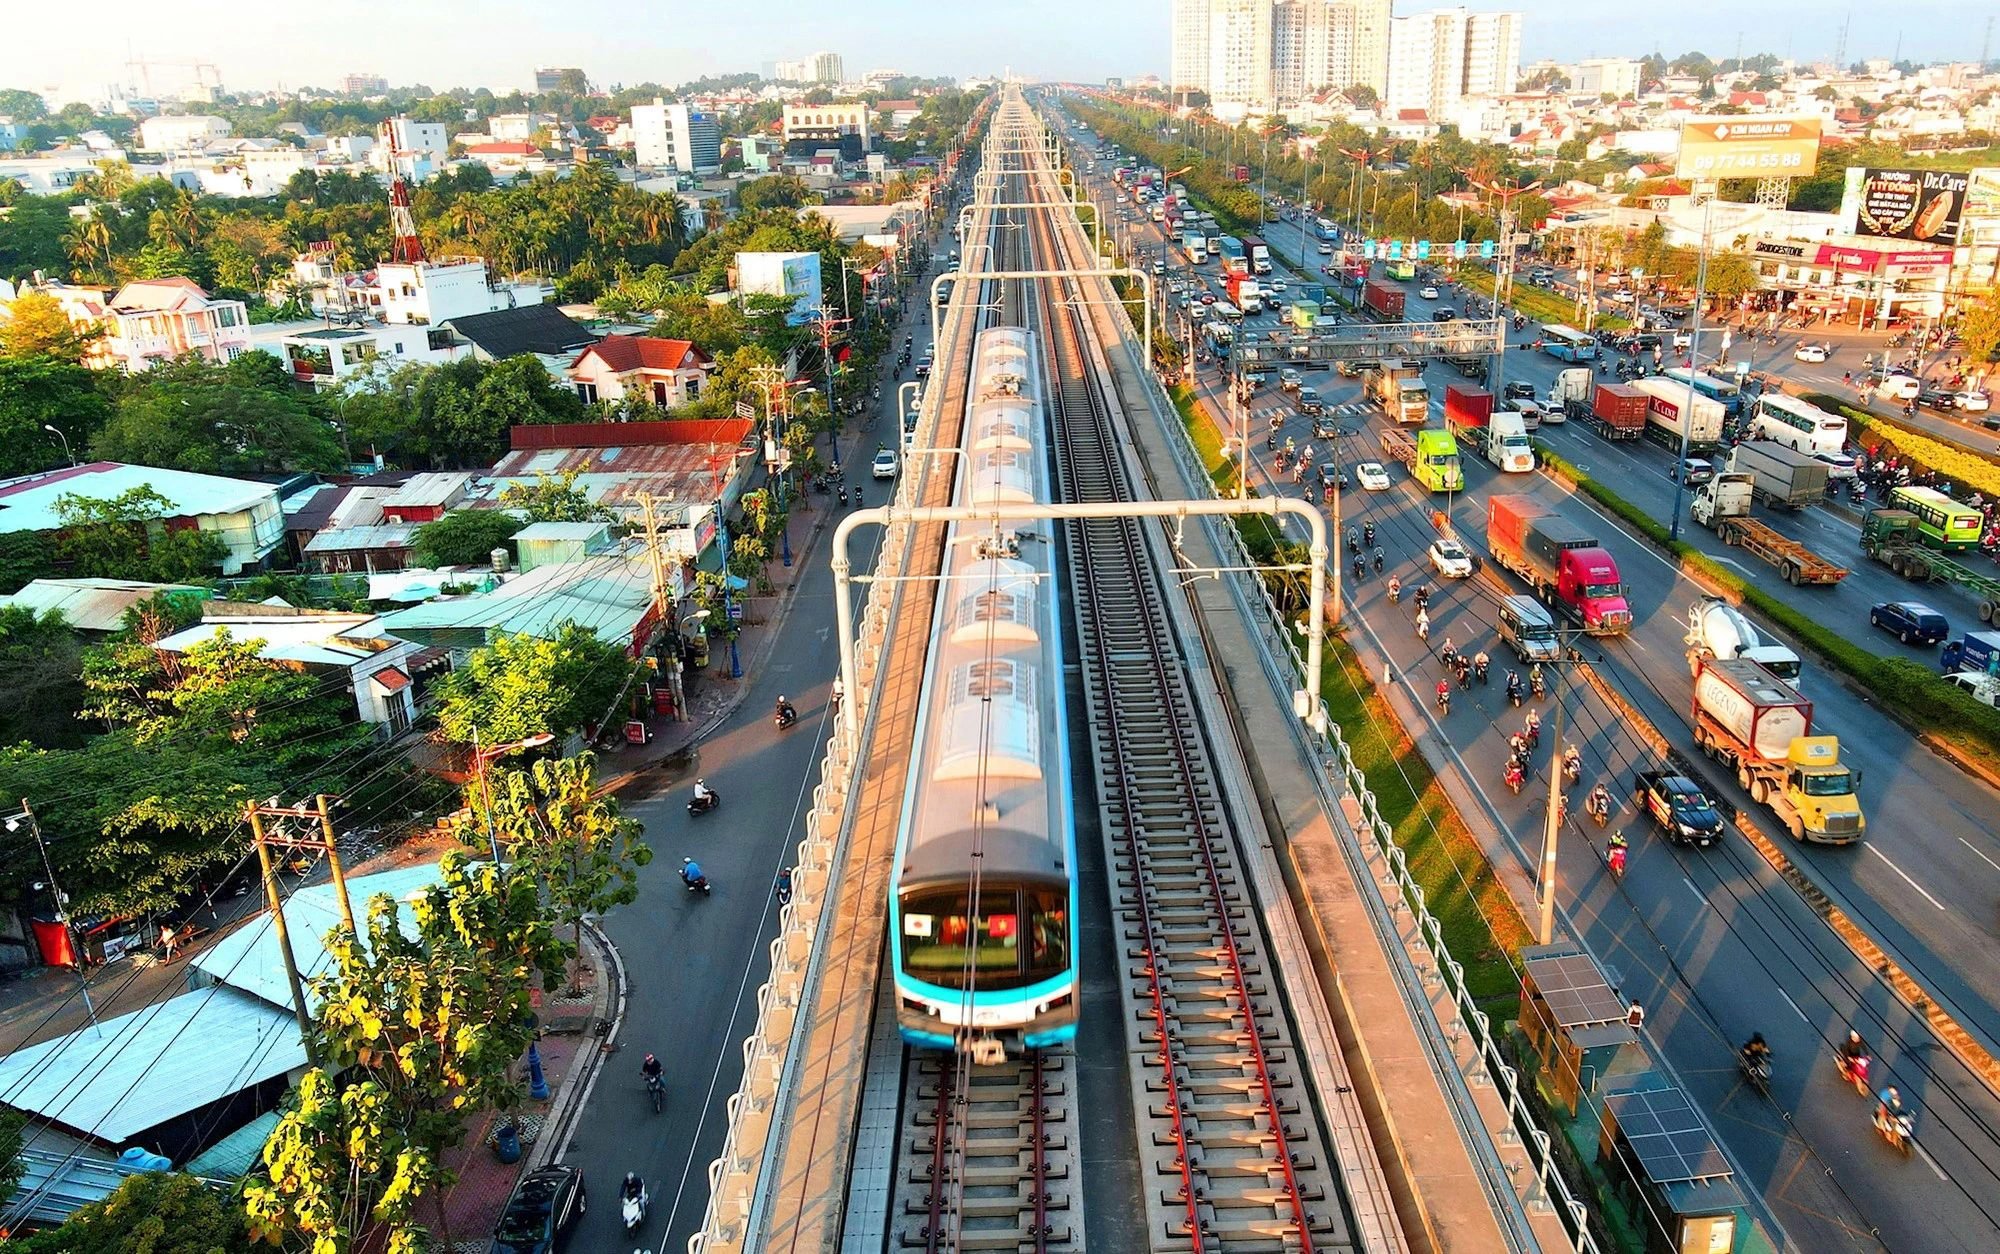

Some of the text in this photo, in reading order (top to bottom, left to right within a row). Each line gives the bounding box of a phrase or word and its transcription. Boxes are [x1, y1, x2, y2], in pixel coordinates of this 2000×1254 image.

[1718, 155, 1736, 168] 77
[1738, 154, 1756, 167] 44
[1783, 152, 1801, 167] 88
[1923, 172, 1968, 192] Dr.Care
[1654, 399, 1661, 411] K
